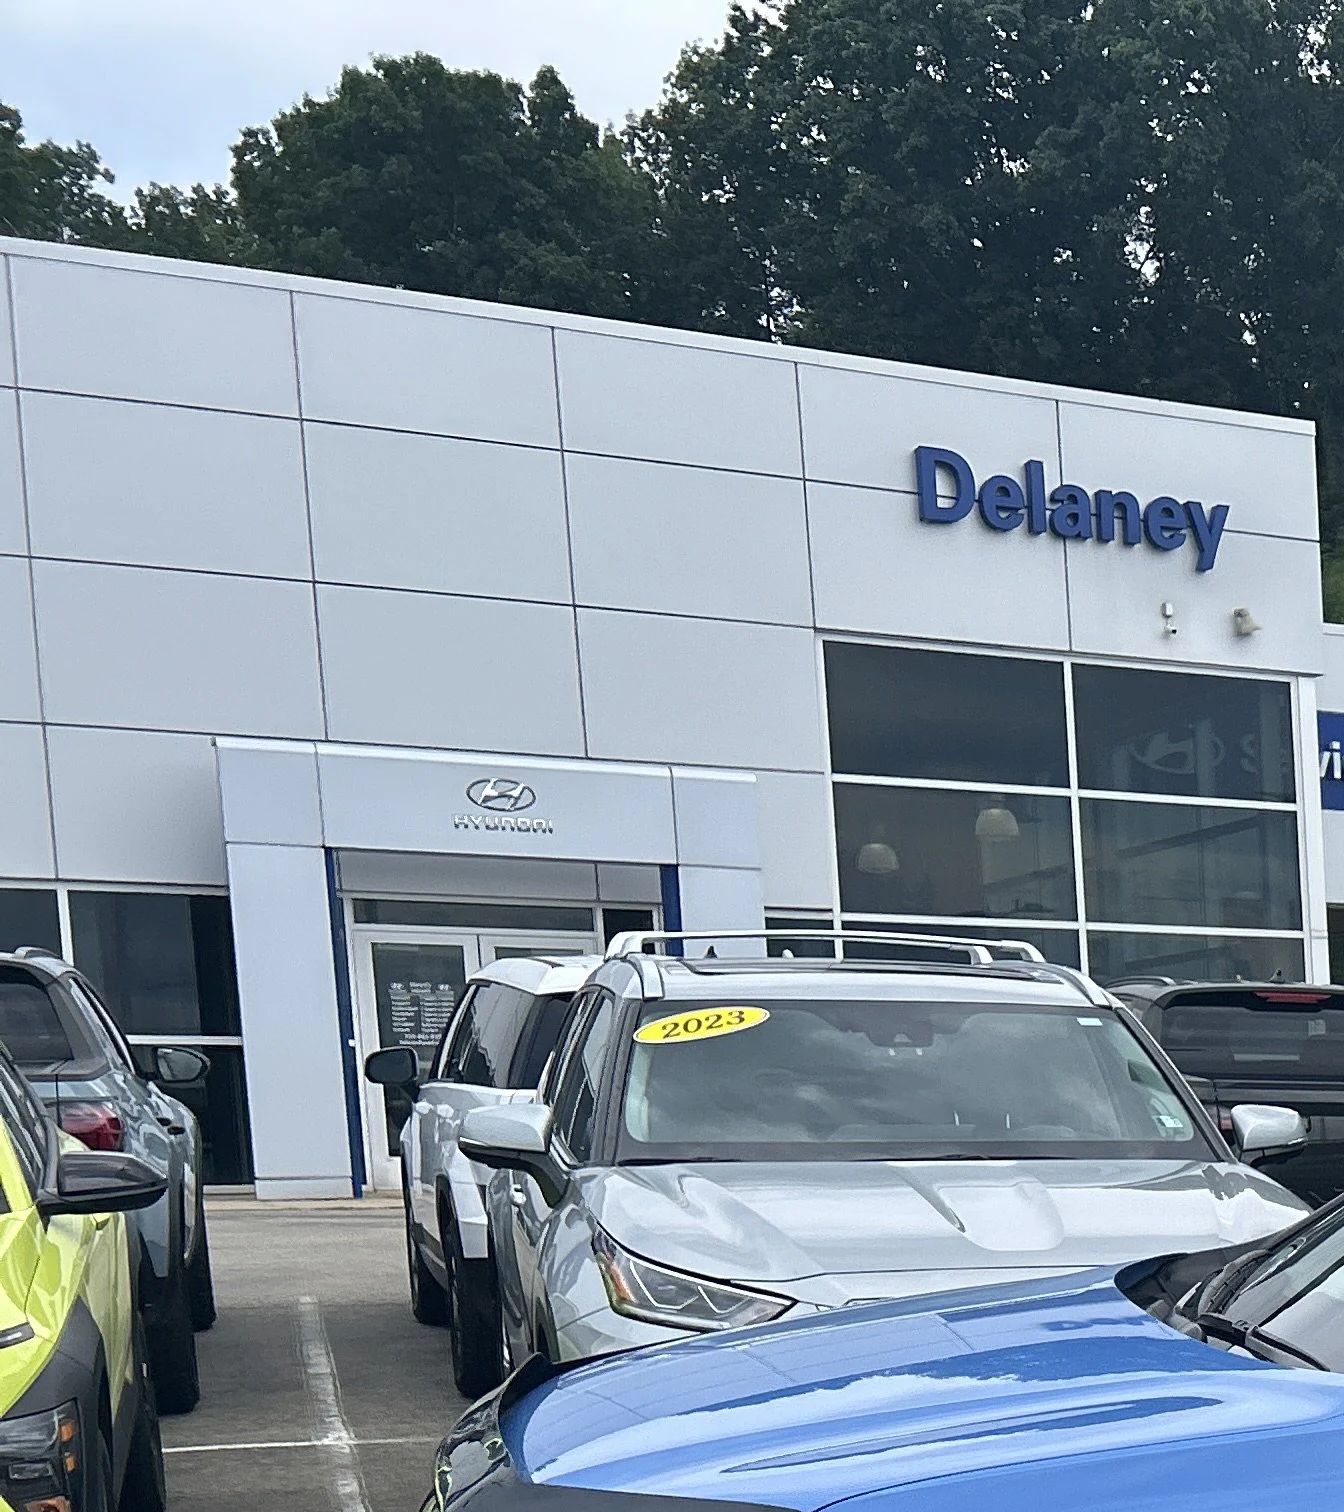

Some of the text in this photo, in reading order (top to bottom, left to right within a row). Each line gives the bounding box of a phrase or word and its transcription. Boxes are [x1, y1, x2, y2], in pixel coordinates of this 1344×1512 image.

[914, 445, 1230, 572] Delaney
[453, 813, 555, 835] HYUNDAI
[661, 1009, 747, 1040] 2023
